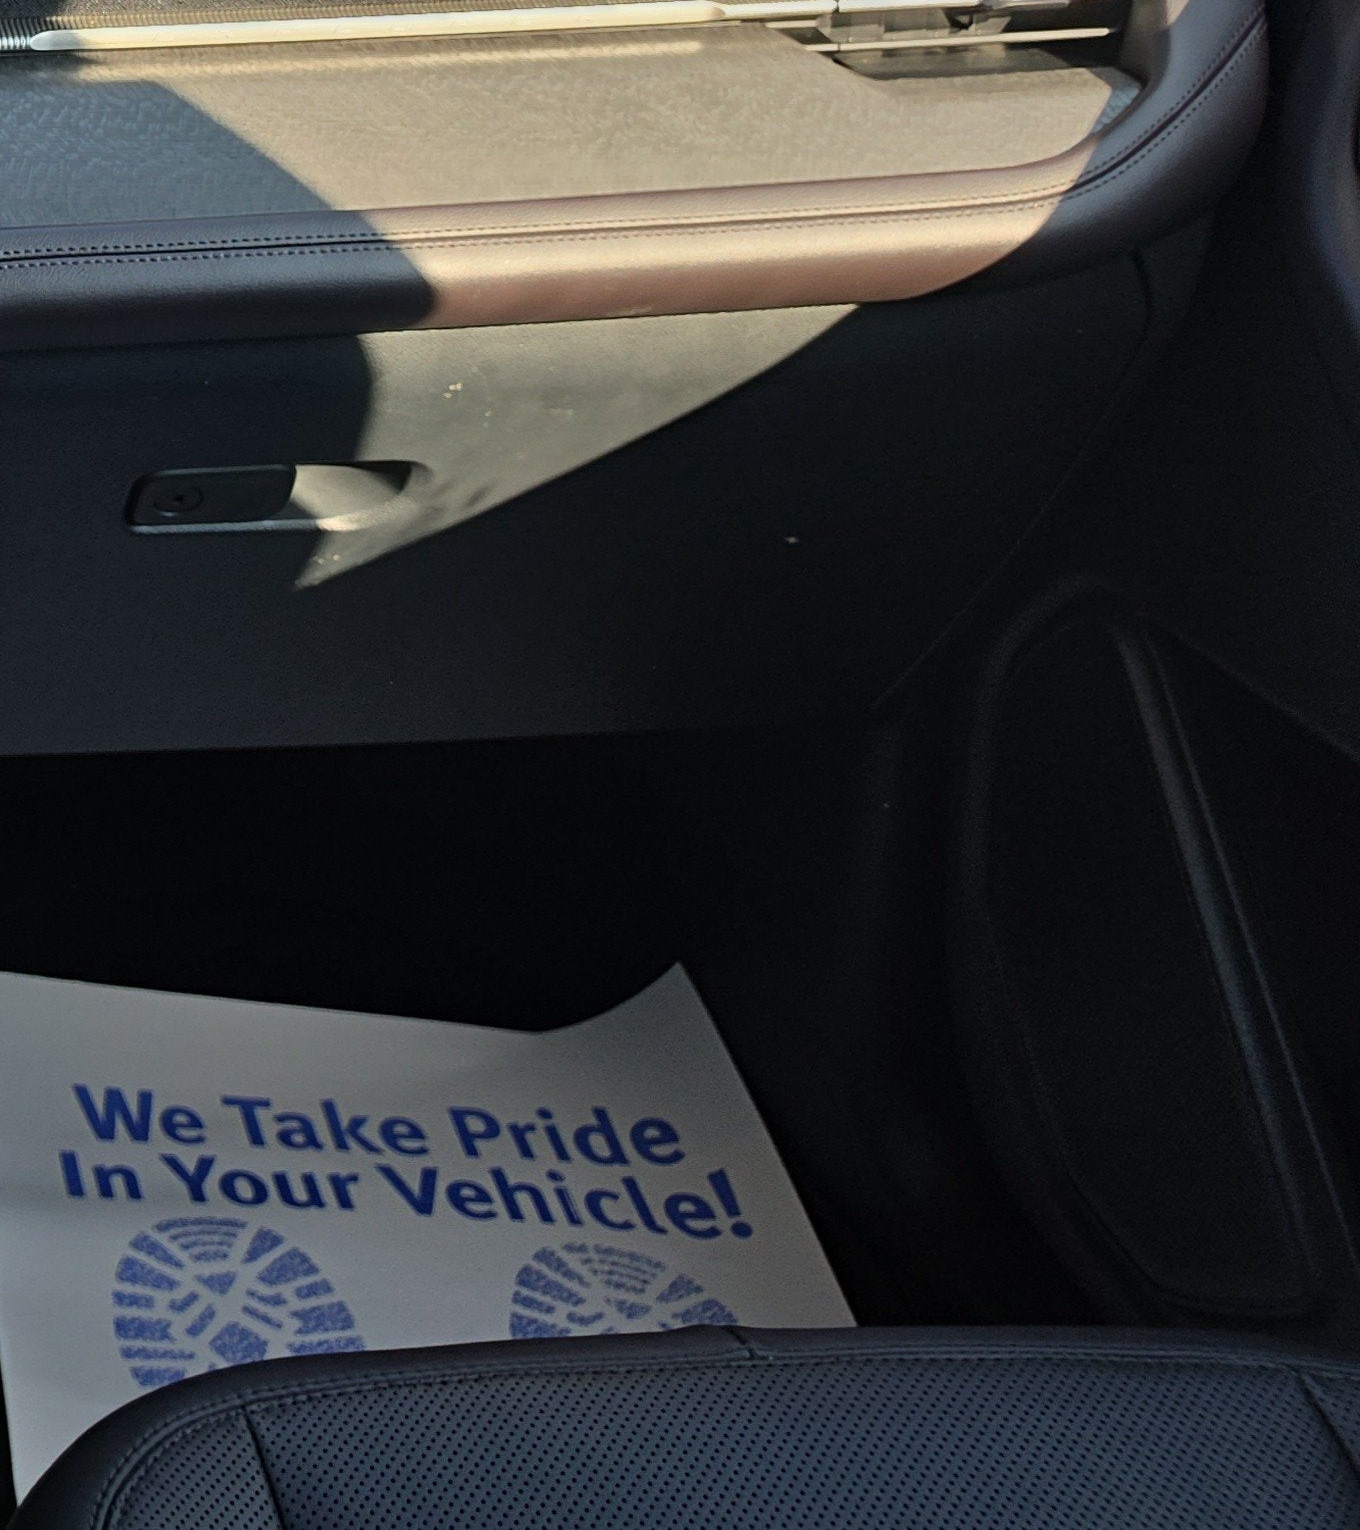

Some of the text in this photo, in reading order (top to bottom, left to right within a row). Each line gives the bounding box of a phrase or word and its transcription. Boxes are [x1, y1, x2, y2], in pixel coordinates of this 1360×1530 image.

[71, 1082, 686, 1167] We Take Pride
[58, 1149, 755, 1241] In Your Vehicle!
